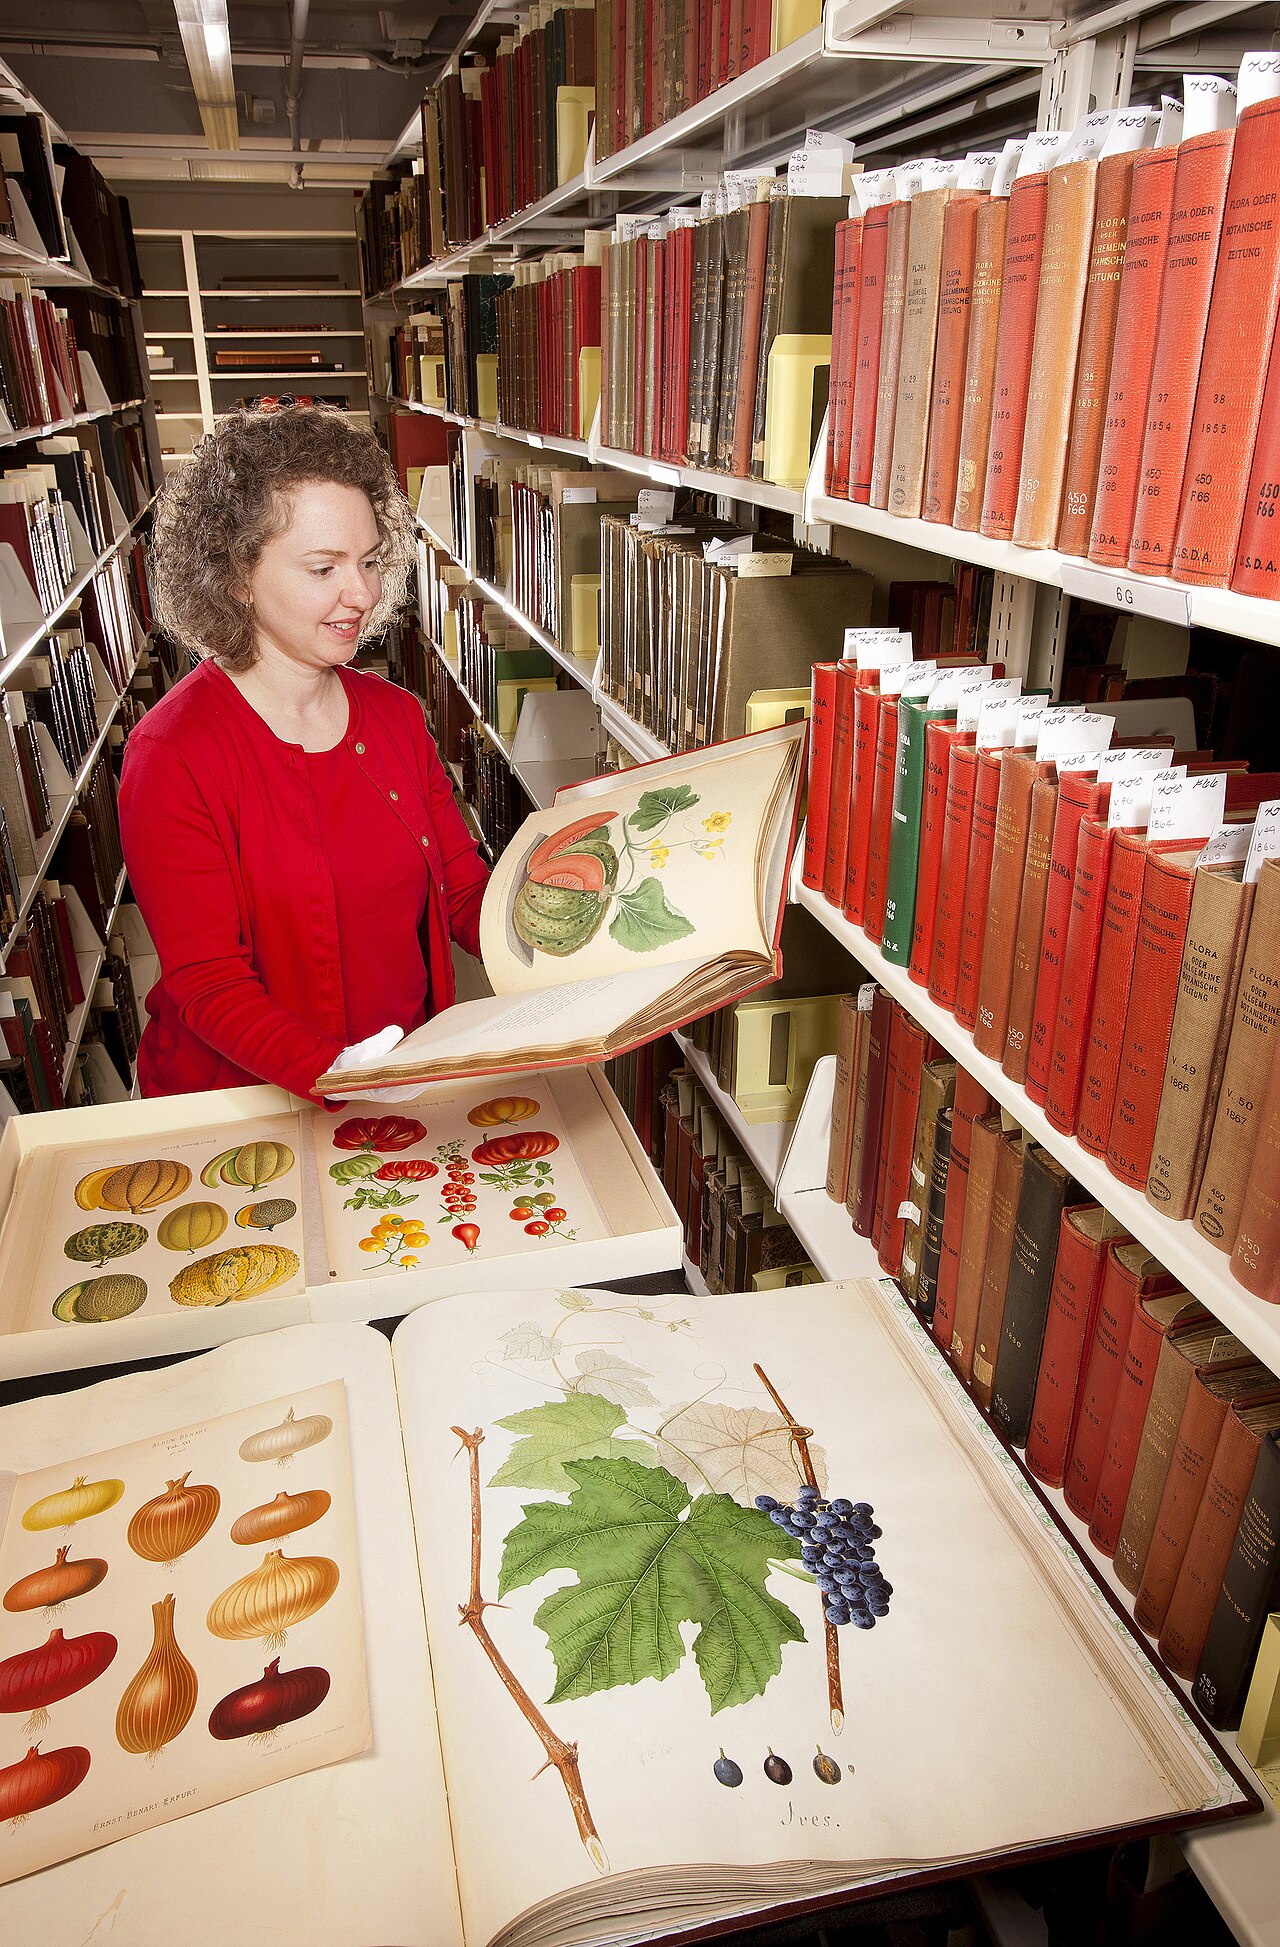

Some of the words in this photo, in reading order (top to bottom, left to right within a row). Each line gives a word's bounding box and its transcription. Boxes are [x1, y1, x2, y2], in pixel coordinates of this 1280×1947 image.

[792, 153, 808, 162] 450
[790, 164, 806, 172] C94
[1229, 198, 1250, 210] FLORA
[1253, 193, 1276, 206] ODER
[1141, 211, 1161, 223] ODER
[1190, 206, 1214, 218] ODER
[1097, 217, 1126, 229] FLORA
[1226, 220, 1272, 235] BOTANISCHE
[1168, 231, 1211, 246] BOTANISCHE
[1228, 248, 1260, 260] ZEITUNG
[912, 264, 926, 272] FLORA
[1169, 257, 1197, 268] ZEITUNG
[865, 276, 877, 286] FLORA
[1001, 388, 1008, 396] 33
[1158, 393, 1168, 402] 37
[1213, 394, 1225, 403] 38
[1078, 399, 1099, 407] 1852
[1107, 419, 1126, 428] 1853
[1149, 421, 1171, 431] 1854
[1201, 424, 1227, 433] 1855
[1146, 469, 1161, 479] 450
[1195, 473, 1212, 484] 450
[1260, 483, 1279, 498] 450
[1068, 492, 1087, 504] 450
[1068, 505, 1085, 514] F66
[1256, 501, 1274, 517] F66
[1052, 860, 1071, 880] FLORA
[1120, 888, 1133, 900] ODER
[1157, 908, 1179, 922] ODER
[1048, 927, 1057, 938] 46
[1141, 937, 1166, 955] ZEITUNG
[1189, 940, 1218, 959] FLORA
[1042, 948, 1059, 966] 1863
[1192, 957, 1207, 969] ODER
[1184, 961, 1221, 983] ALLGEMEINE
[1249, 968, 1279, 989] FLORA
[1182, 972, 1219, 994] BOTANISCHE
[1184, 984, 1208, 1001] ZEITUNG
[1251, 985, 1267, 998] ODER
[1243, 990, 1280, 1016] ALLGEMEINE
[980, 1005, 993, 1020] 450
[1241, 1001, 1277, 1027] BOTANISCHE
[1036, 1021, 1046, 1036] 450
[1242, 1014, 1268, 1034] ZEITUNG
[1132, 1042, 1143, 1052] 48
[1182, 1064, 1196, 1075] 49
[1088, 1075, 1101, 1088] 450
[1170, 1076, 1189, 1092] 1866
[1122, 1098, 1136, 1112] 450
[1238, 1097, 1253, 1111] 50
[1226, 1108, 1247, 1125] 1867
[1158, 1154, 1171, 1167] 450
[1211, 1188, 1226, 1201] 450
[1018, 1223, 1040, 1252] BOTANICAL
[1241, 1234, 1260, 1255] 450
[93, 1816, 122, 1831] ERNST
